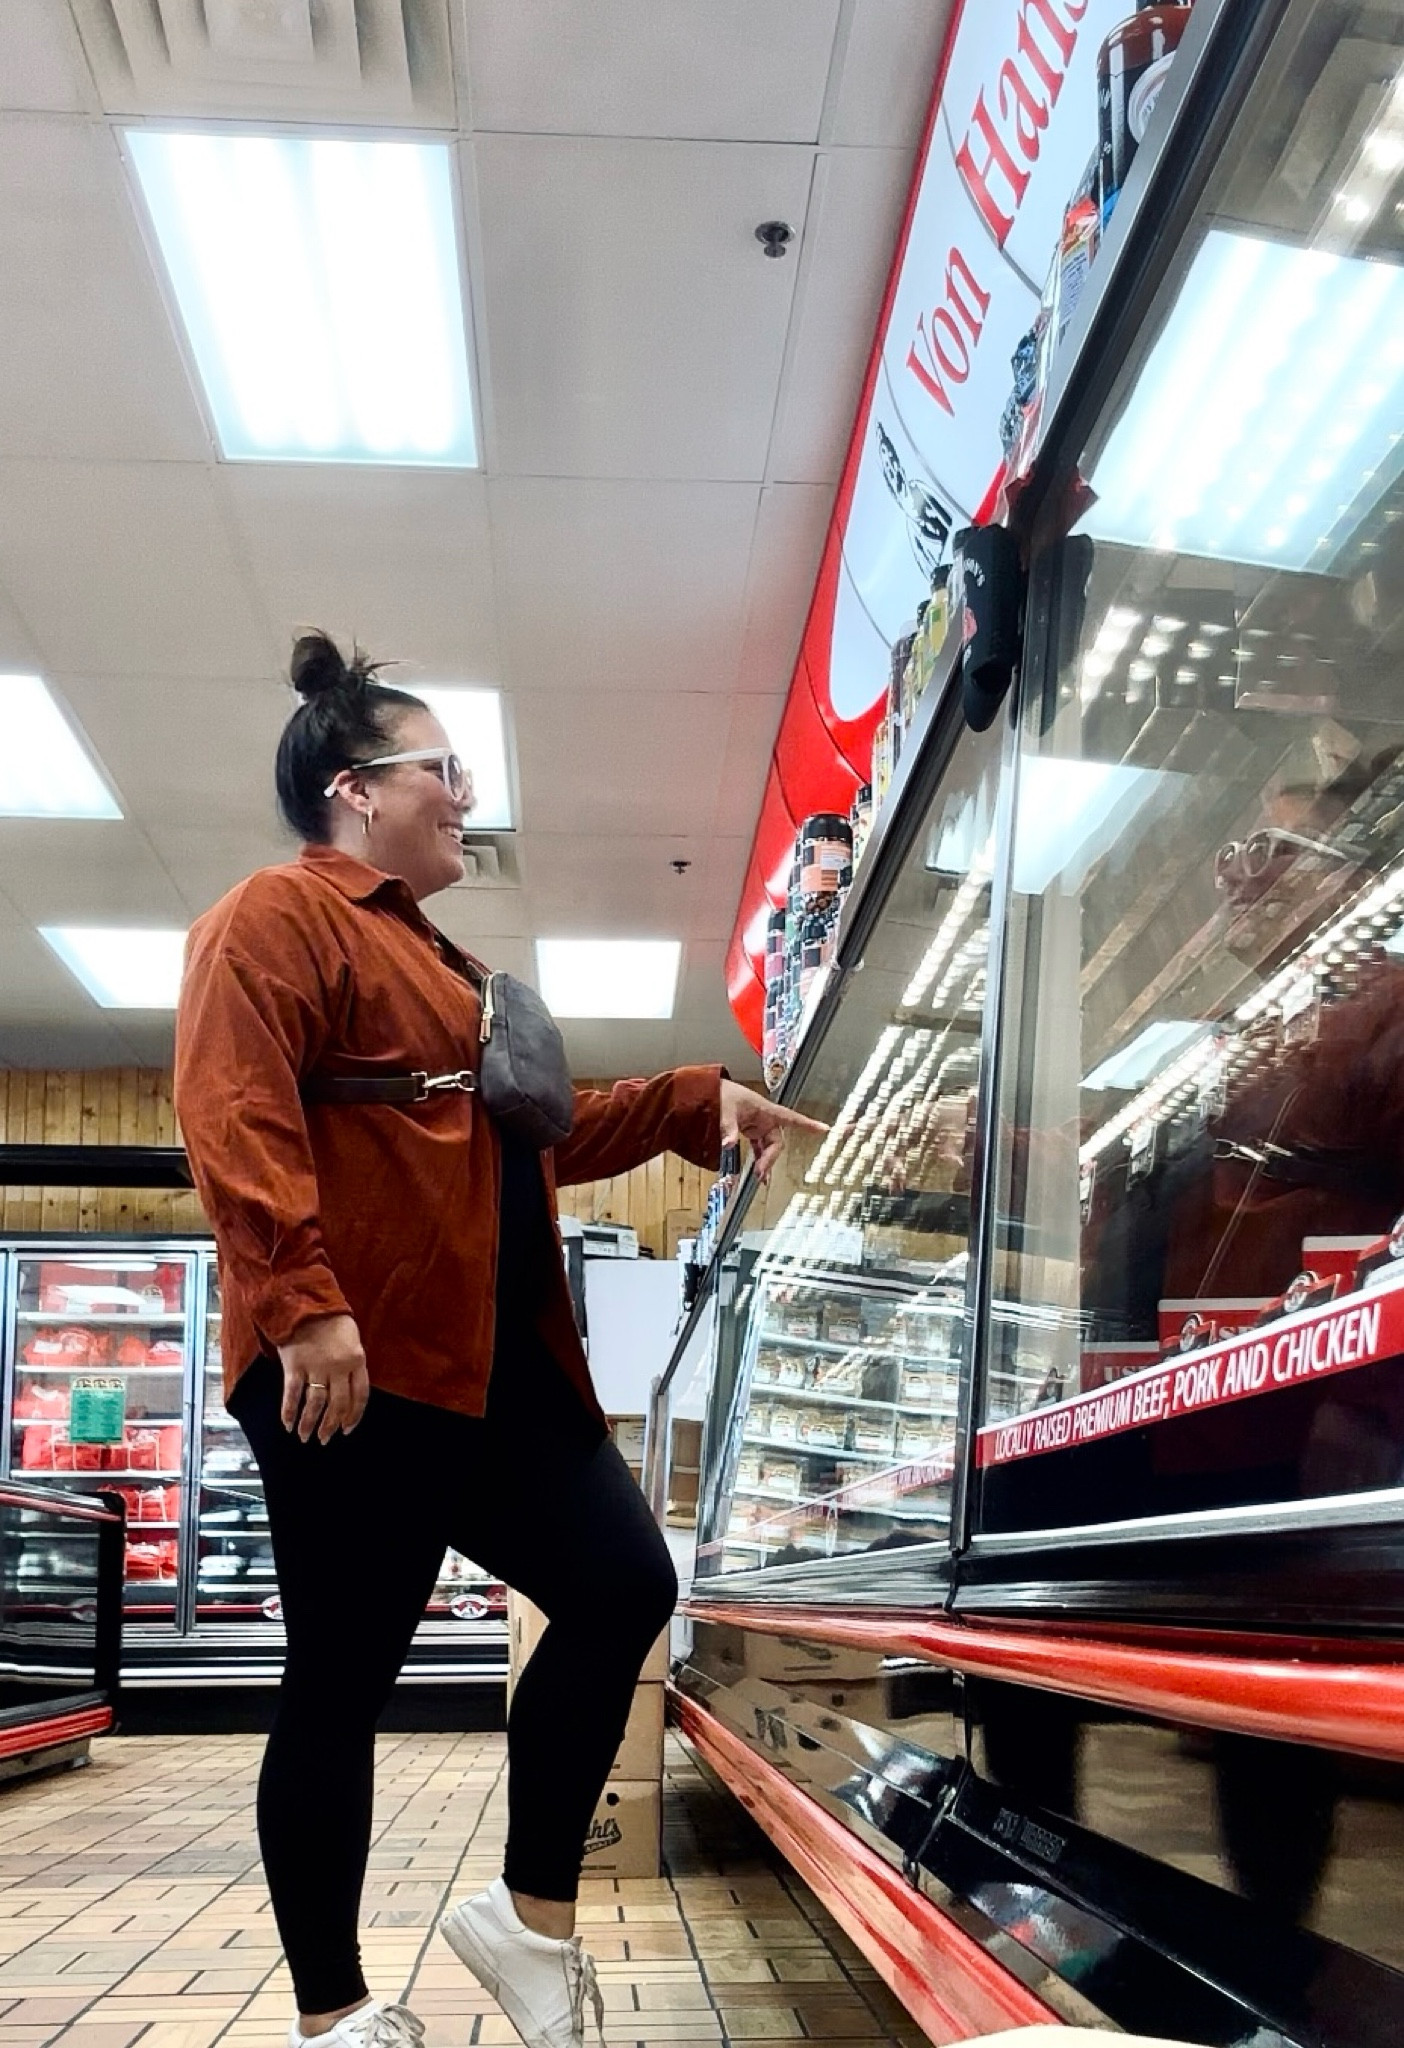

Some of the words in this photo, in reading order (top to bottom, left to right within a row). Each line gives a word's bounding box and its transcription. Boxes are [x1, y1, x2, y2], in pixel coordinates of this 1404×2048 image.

[906, 246, 991, 417] Von
[994, 1421, 1034, 1461] LOCALLY
[1033, 1410, 1072, 1451] RAISED
[1073, 1388, 1133, 1440] PREMIUM
[1132, 1375, 1171, 1423] BEEF,
[1172, 1356, 1223, 1411] PORK
[1222, 1343, 1270, 1397] AND
[1273, 1302, 1382, 1382] CHICKEN
